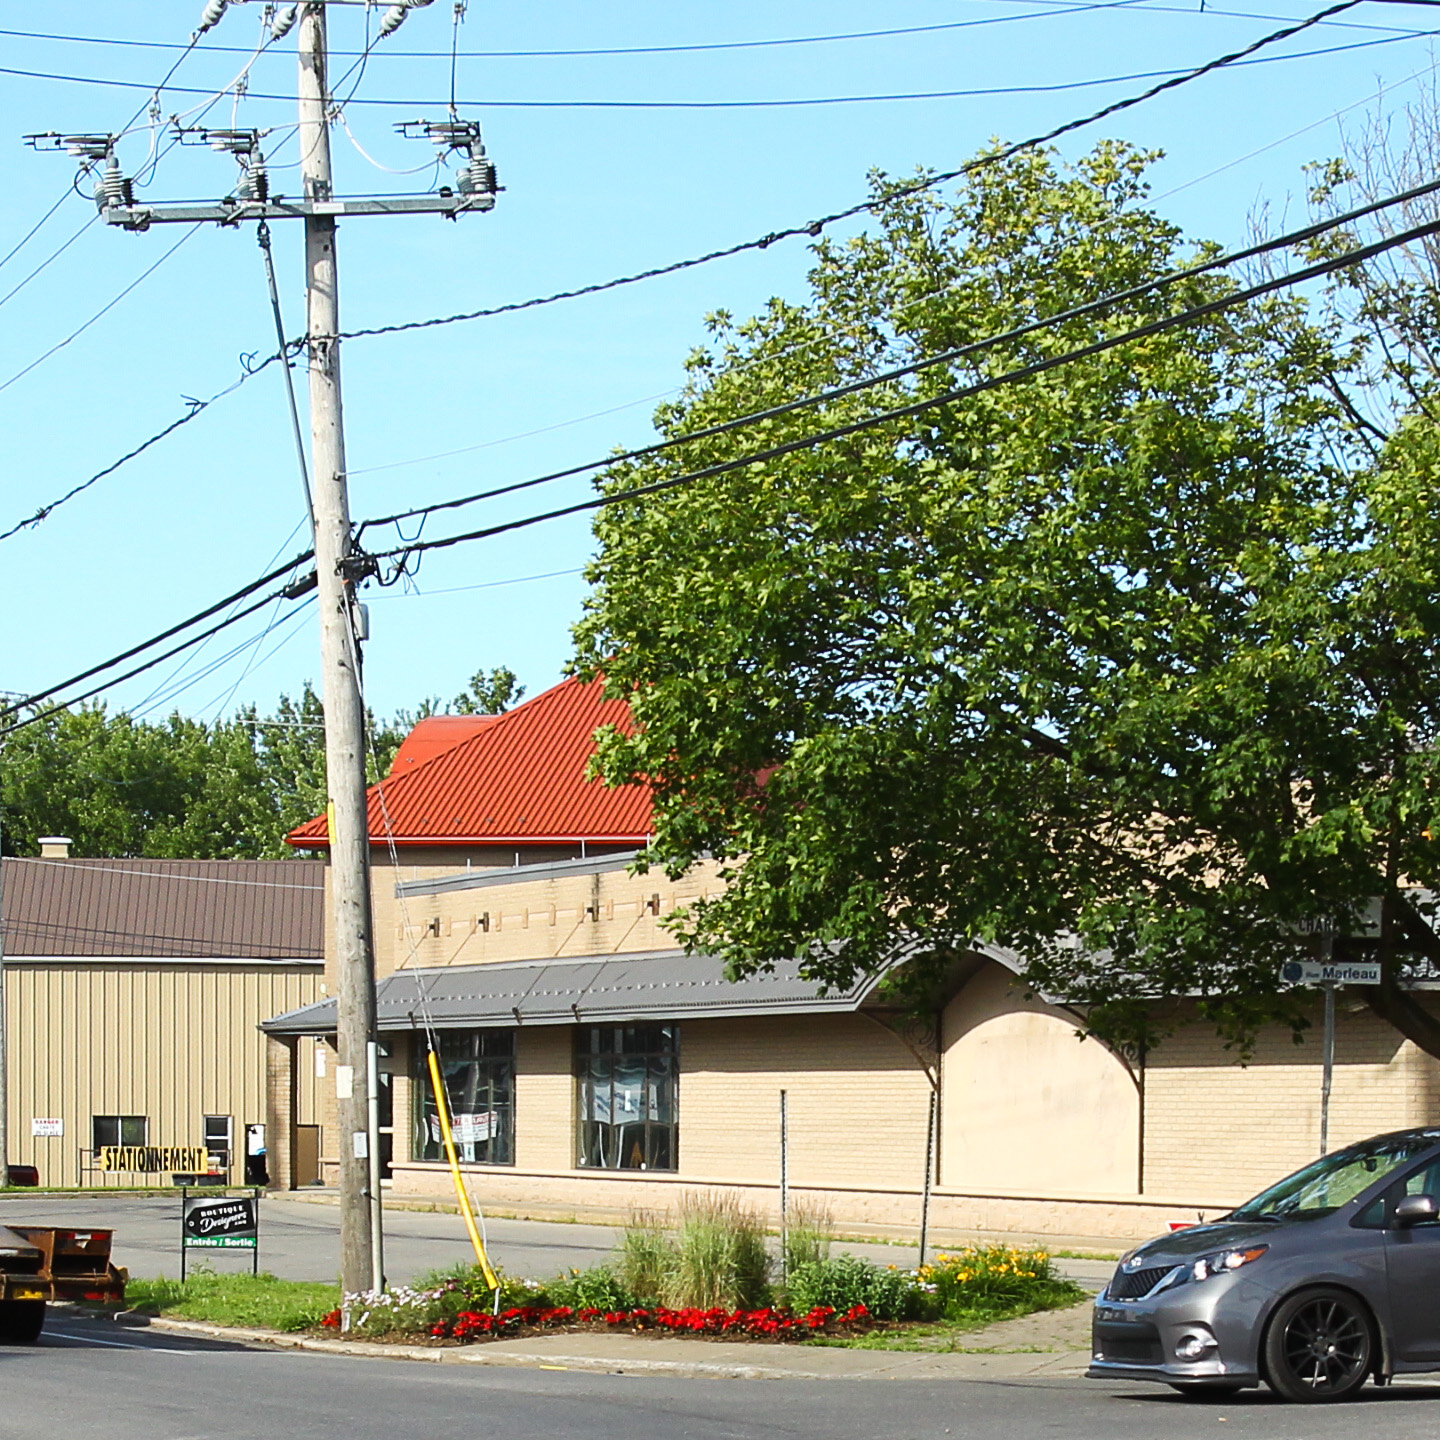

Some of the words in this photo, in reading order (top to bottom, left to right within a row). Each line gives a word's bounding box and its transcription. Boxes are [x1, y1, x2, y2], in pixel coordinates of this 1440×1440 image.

[1322, 966, 1378, 980] Marleau
[105, 1147, 203, 1171] STATIONNEMENT
[187, 1237, 218, 1247] Entrée
[224, 1237, 254, 1247] Sortie
